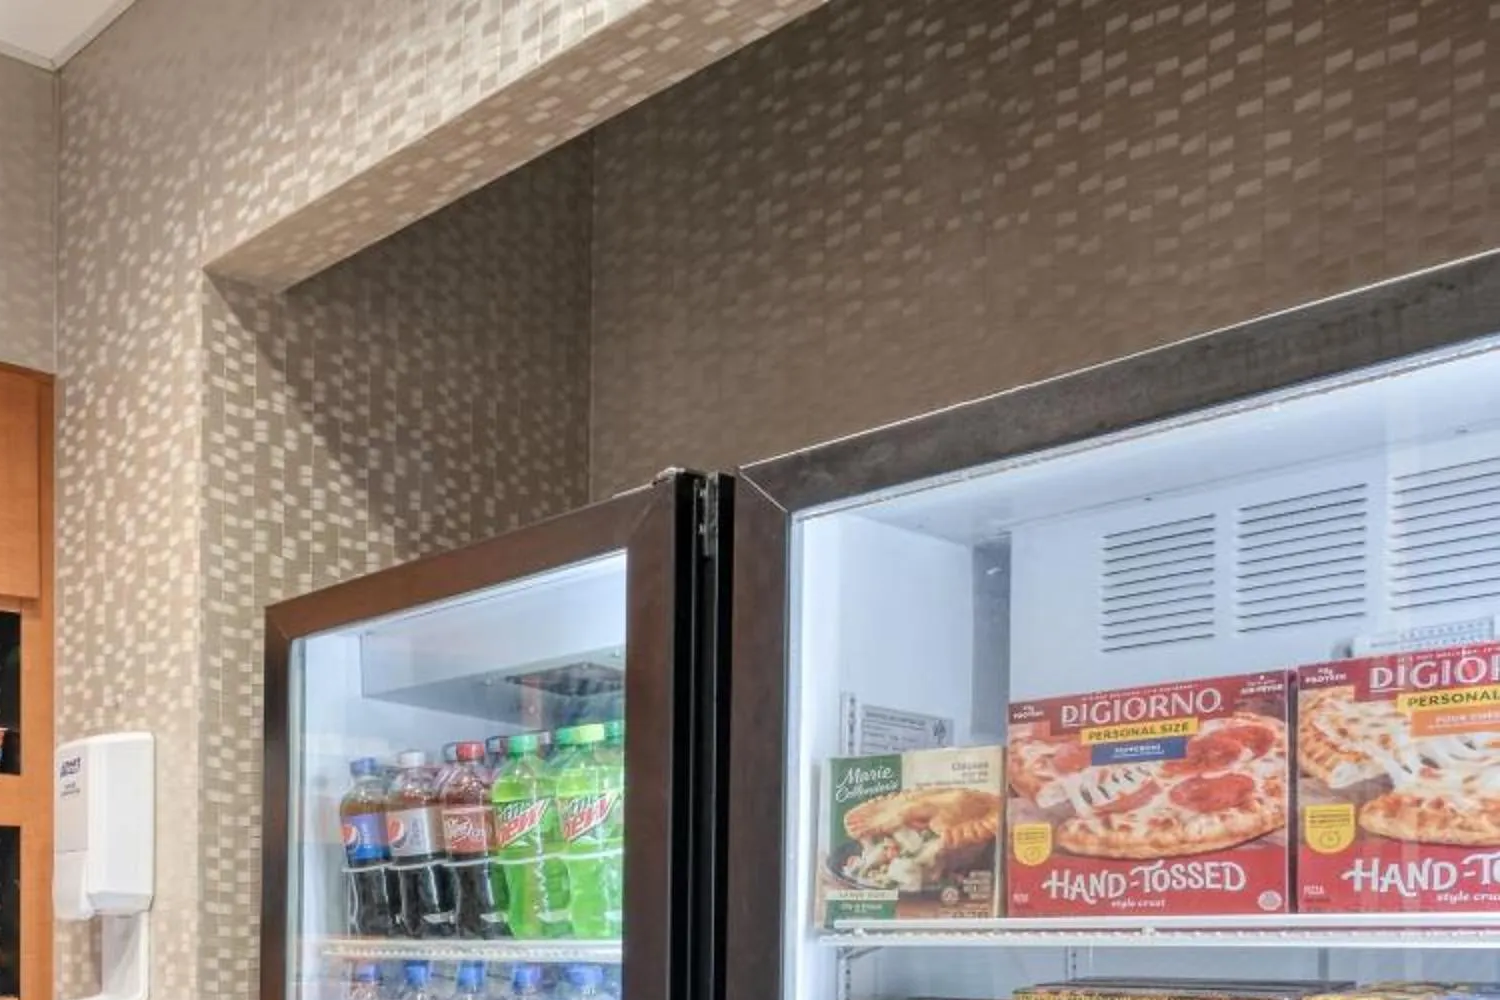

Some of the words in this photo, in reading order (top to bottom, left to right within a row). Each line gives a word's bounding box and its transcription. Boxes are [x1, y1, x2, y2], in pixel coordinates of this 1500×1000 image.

[1061, 687, 1221, 727] DIGIORNO
[1087, 727, 1157, 741] PERSONAL
[1160, 722, 1190, 733] SIZE
[1340, 851, 1500, 897] HAND-T
[1473, 892, 1500, 903] cru
